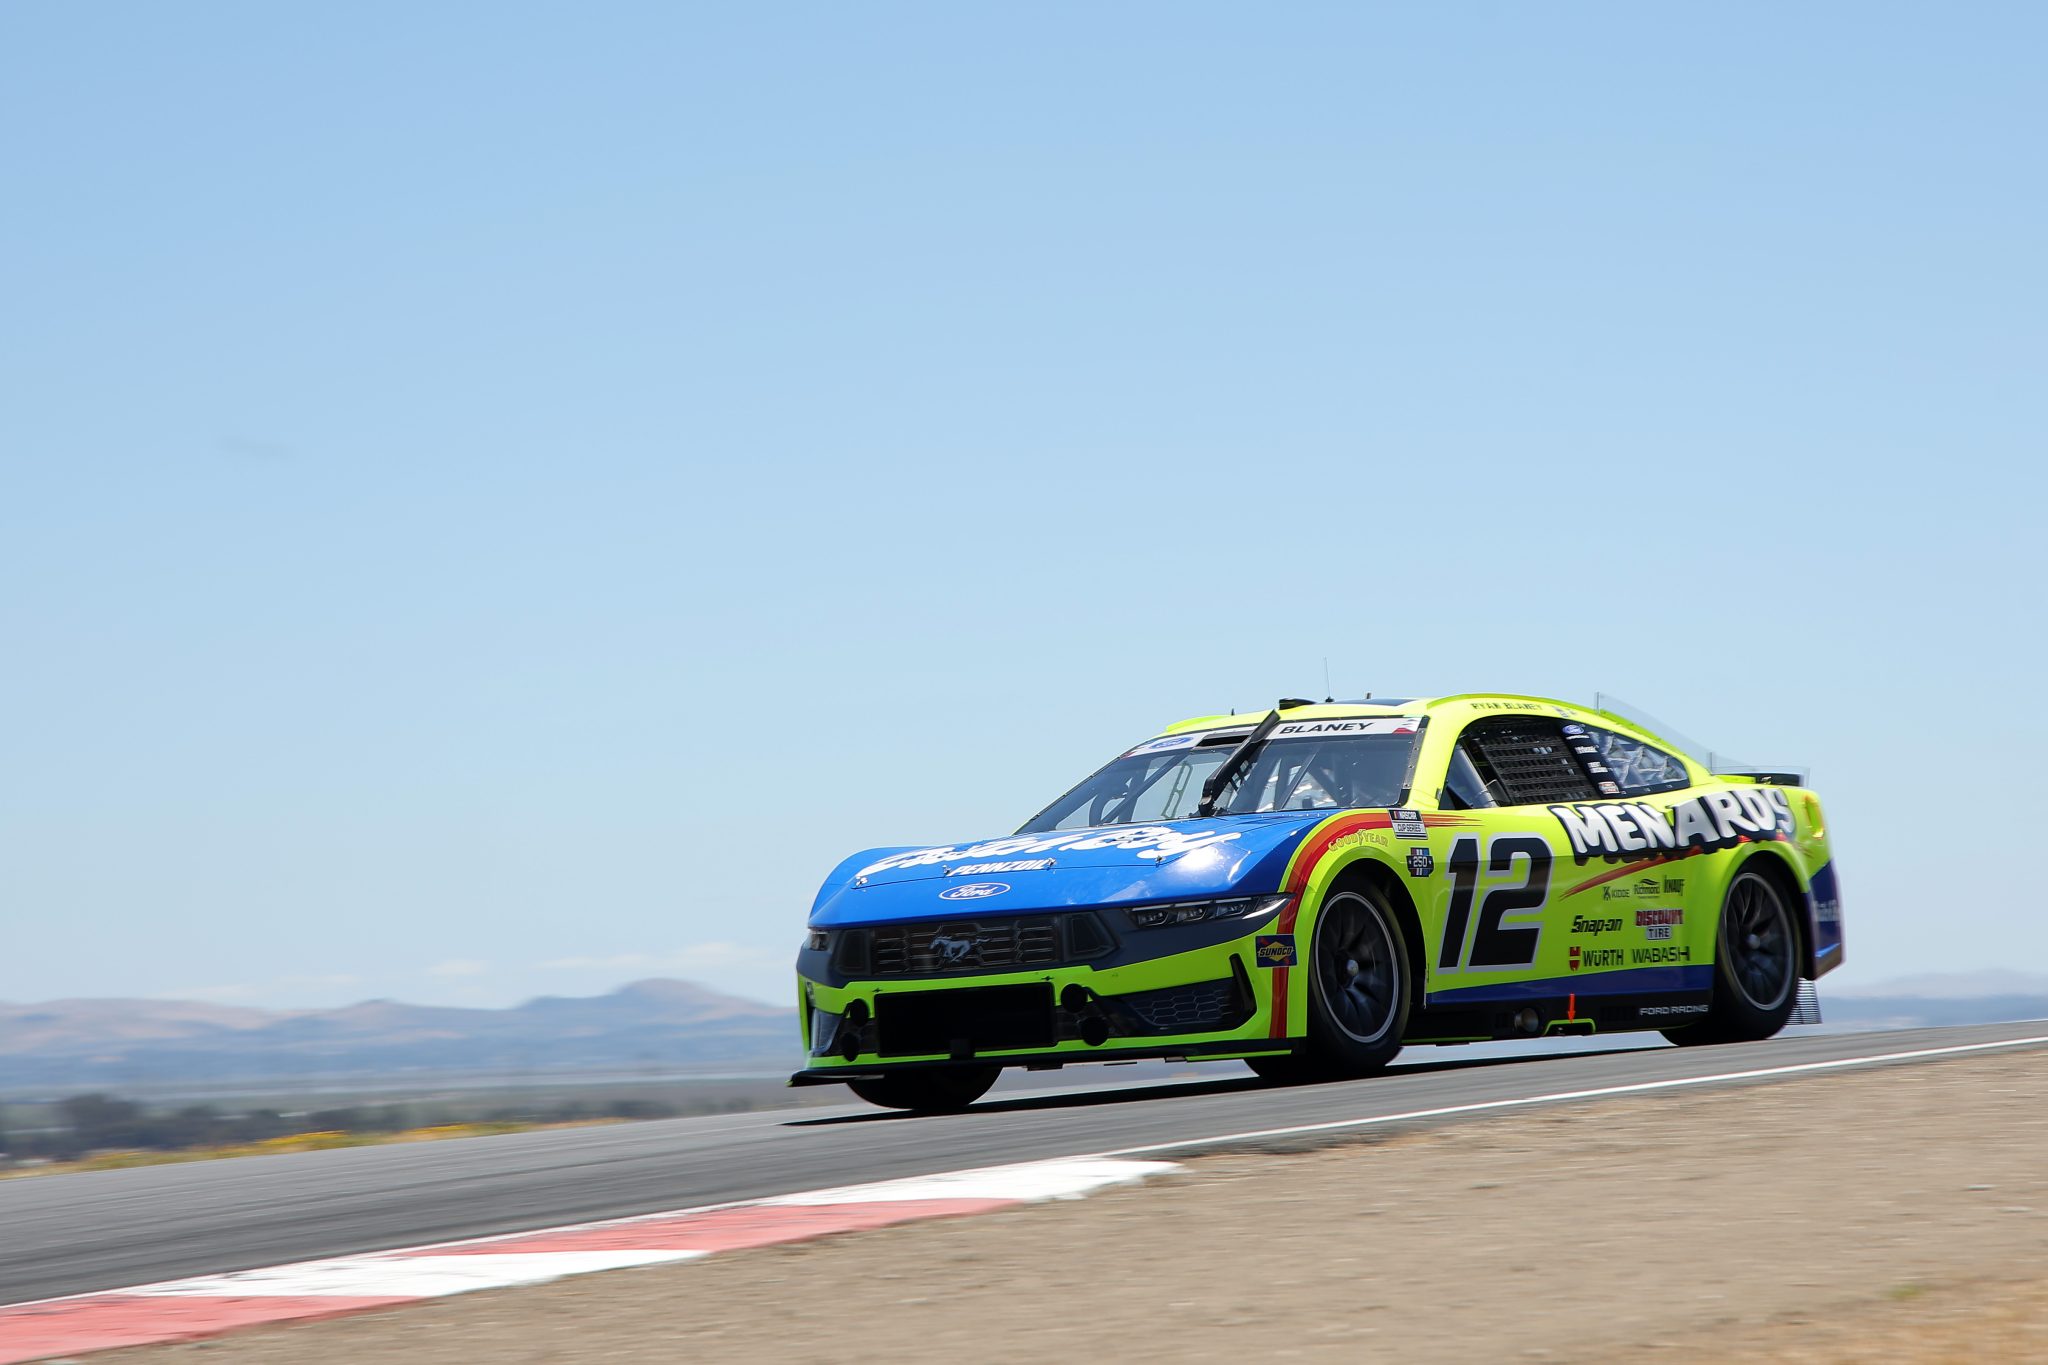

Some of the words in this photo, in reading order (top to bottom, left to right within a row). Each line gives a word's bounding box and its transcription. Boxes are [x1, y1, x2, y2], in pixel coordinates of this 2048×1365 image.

[1502, 702, 1543, 710] BLANEY
[1279, 721, 1374, 735] BLANEY
[1549, 788, 1796, 855] MENARDS
[1327, 829, 1390, 852] GOODYEAR
[945, 859, 1049, 877] PENNZOIL
[1412, 856, 1428, 867] 250
[950, 884, 999, 898] Ford
[1437, 835, 1550, 972] 12
[1571, 914, 1623, 937] Snap-on
[1635, 909, 1684, 926] DISCOUNT
[1648, 928, 1670, 938] TIRE
[1260, 947, 1293, 957] SUNOCO
[1583, 948, 1624, 967] WÜRTH
[1632, 946, 1691, 963] WABASH
[1640, 1006, 1670, 1016] FORD
[1671, 1004, 1709, 1014] RACING
